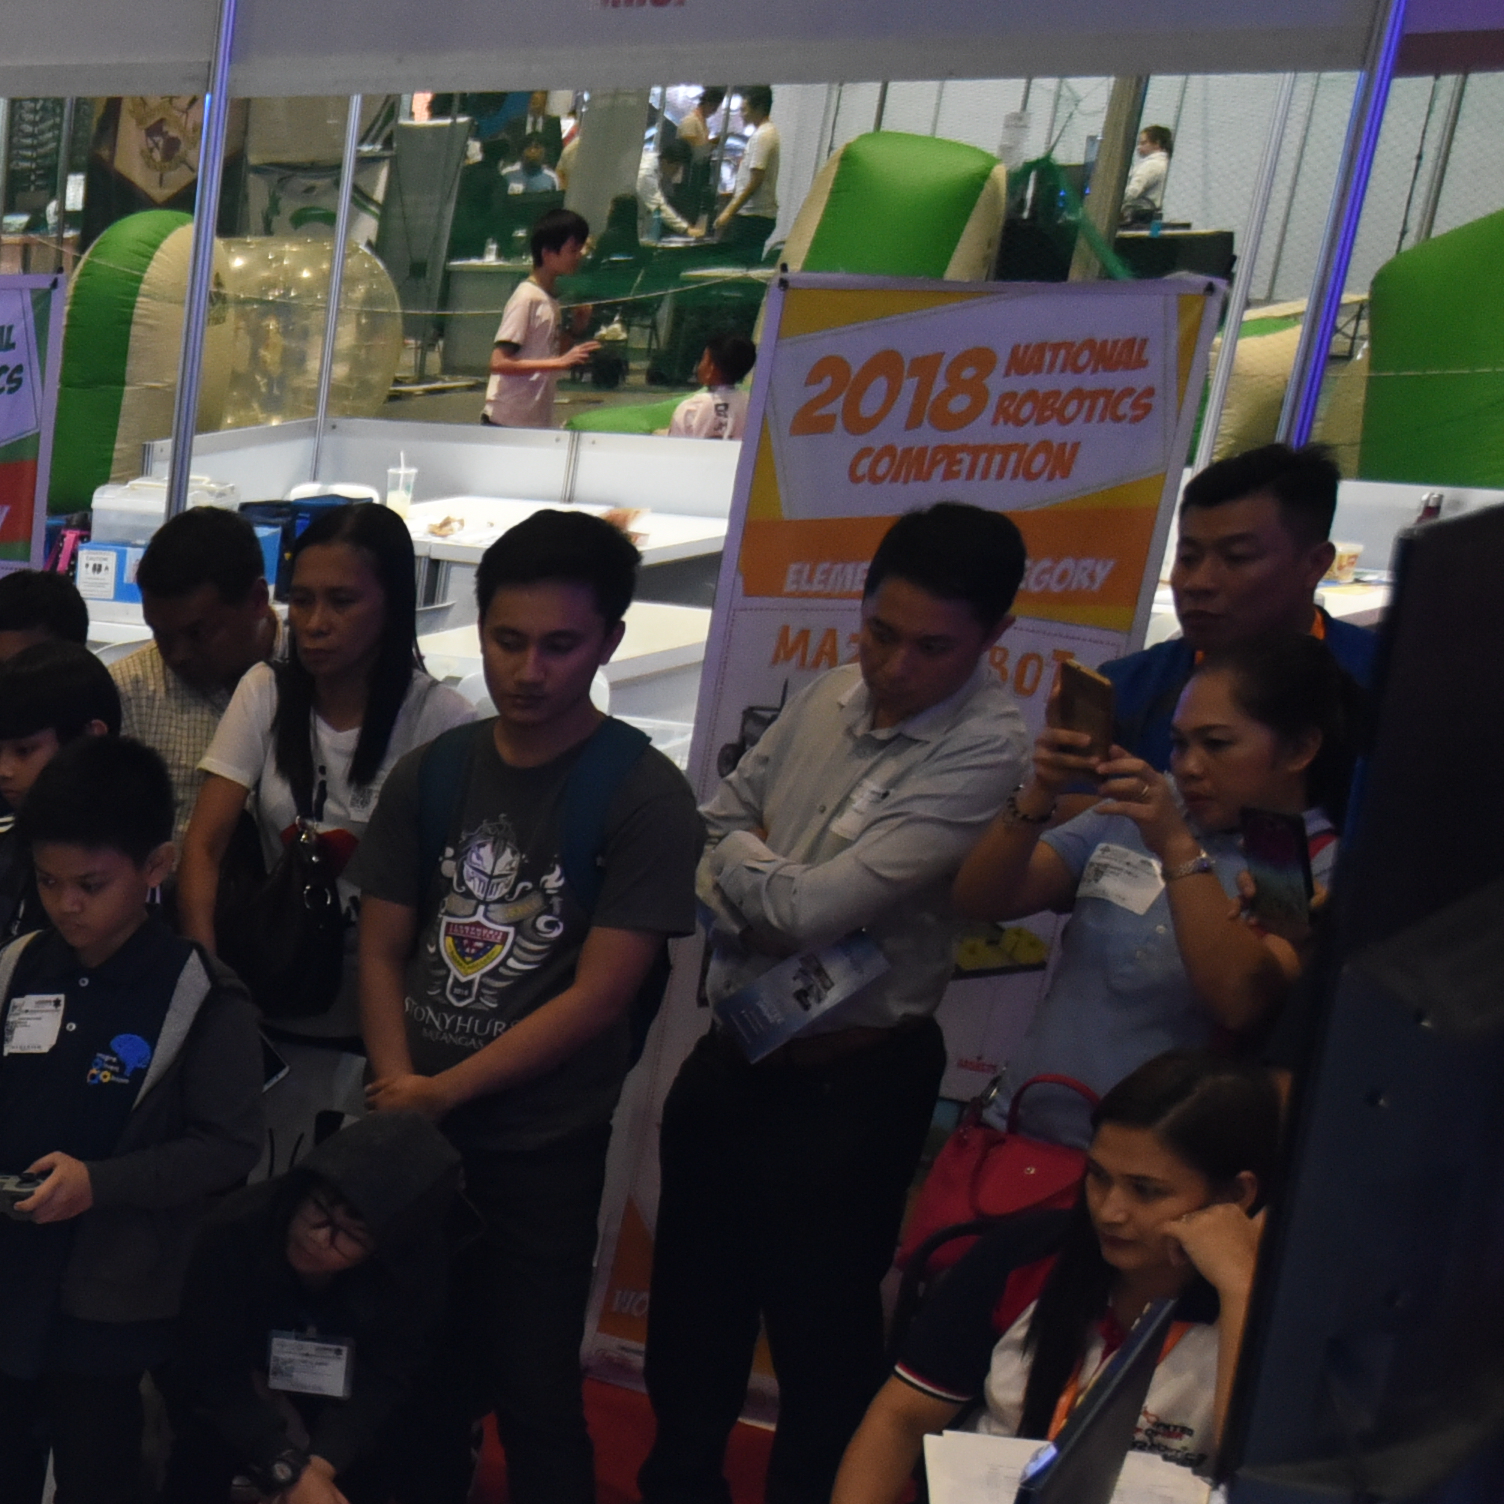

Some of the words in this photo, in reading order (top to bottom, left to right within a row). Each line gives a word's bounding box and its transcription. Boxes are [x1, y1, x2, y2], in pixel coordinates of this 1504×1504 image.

[1004, 337, 1149, 378] NATIONAL
[789, 347, 997, 436] 2018
[991, 387, 1156, 428] ROBOTICS
[848, 440, 1081, 485] COMPETITION
[784, 561, 868, 593] ELEME
[1022, 558, 1119, 593] EGORY
